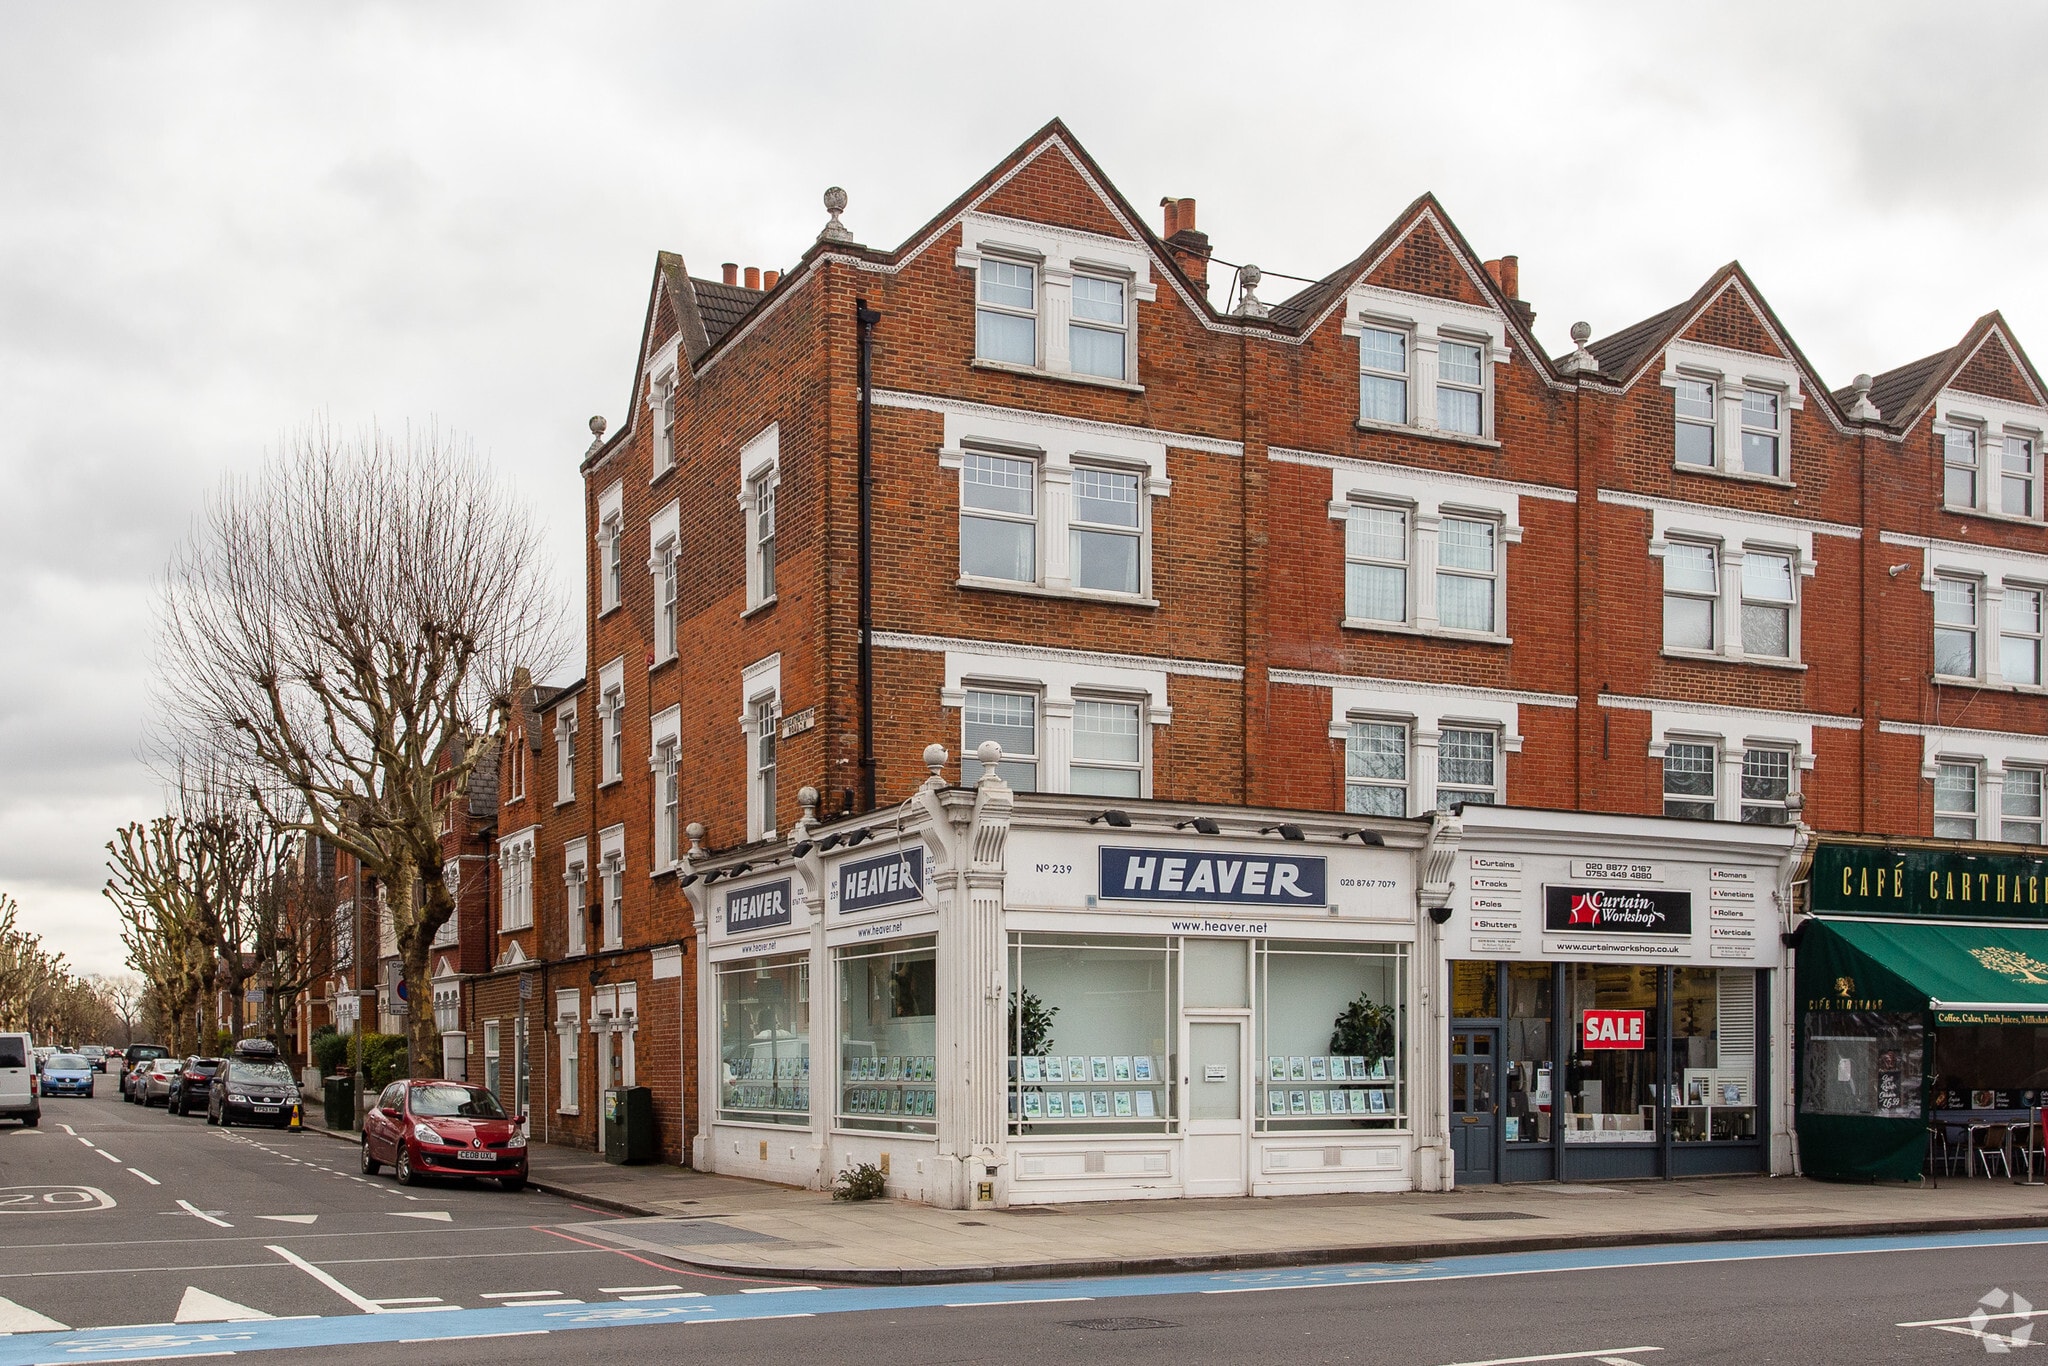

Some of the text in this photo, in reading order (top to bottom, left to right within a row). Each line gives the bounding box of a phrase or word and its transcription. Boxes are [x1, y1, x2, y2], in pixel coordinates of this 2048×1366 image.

[1052, 864, 1072, 875] 239
[1479, 859, 1515, 868] Curtains
[1585, 862, 1652, 872] 020 8877 0167
[844, 861, 917, 901] HEAVER
[1124, 855, 1313, 898] HEAVER
[1718, 871, 1747, 879] Romans
[1843, 861, 1904, 898] CAFÉ
[1340, 877, 1397, 889] 020 8767 7079
[1479, 880, 1508, 888] Tracks
[830, 890, 838, 900] 239
[1592, 890, 1650, 910] Curtain
[1719, 890, 1754, 898] Venetians
[730, 889, 786, 923] HEAVER
[1479, 900, 1503, 908] Poles
[1602, 908, 1656, 927] Workshop
[858, 920, 903, 937] www.heaver.net
[1172, 920, 1268, 934] www.heaver.net
[1479, 921, 1518, 929] Shutters
[741, 941, 777, 954] www.heaver.net
[1557, 943, 1680, 953] www.curtainworkshop.co.uk
[1938, 1013, 1962, 1024] Coffee,
[1962, 1013, 1983, 1024] Cakes,
[1984, 1014, 2001, 1023] Fresh
[2001, 1014, 2020, 1025] Juices,
[1585, 1017, 1642, 1042] SALE
[480, 1152, 494, 1160] UXL
[0, 1192, 94, 1204] 20
